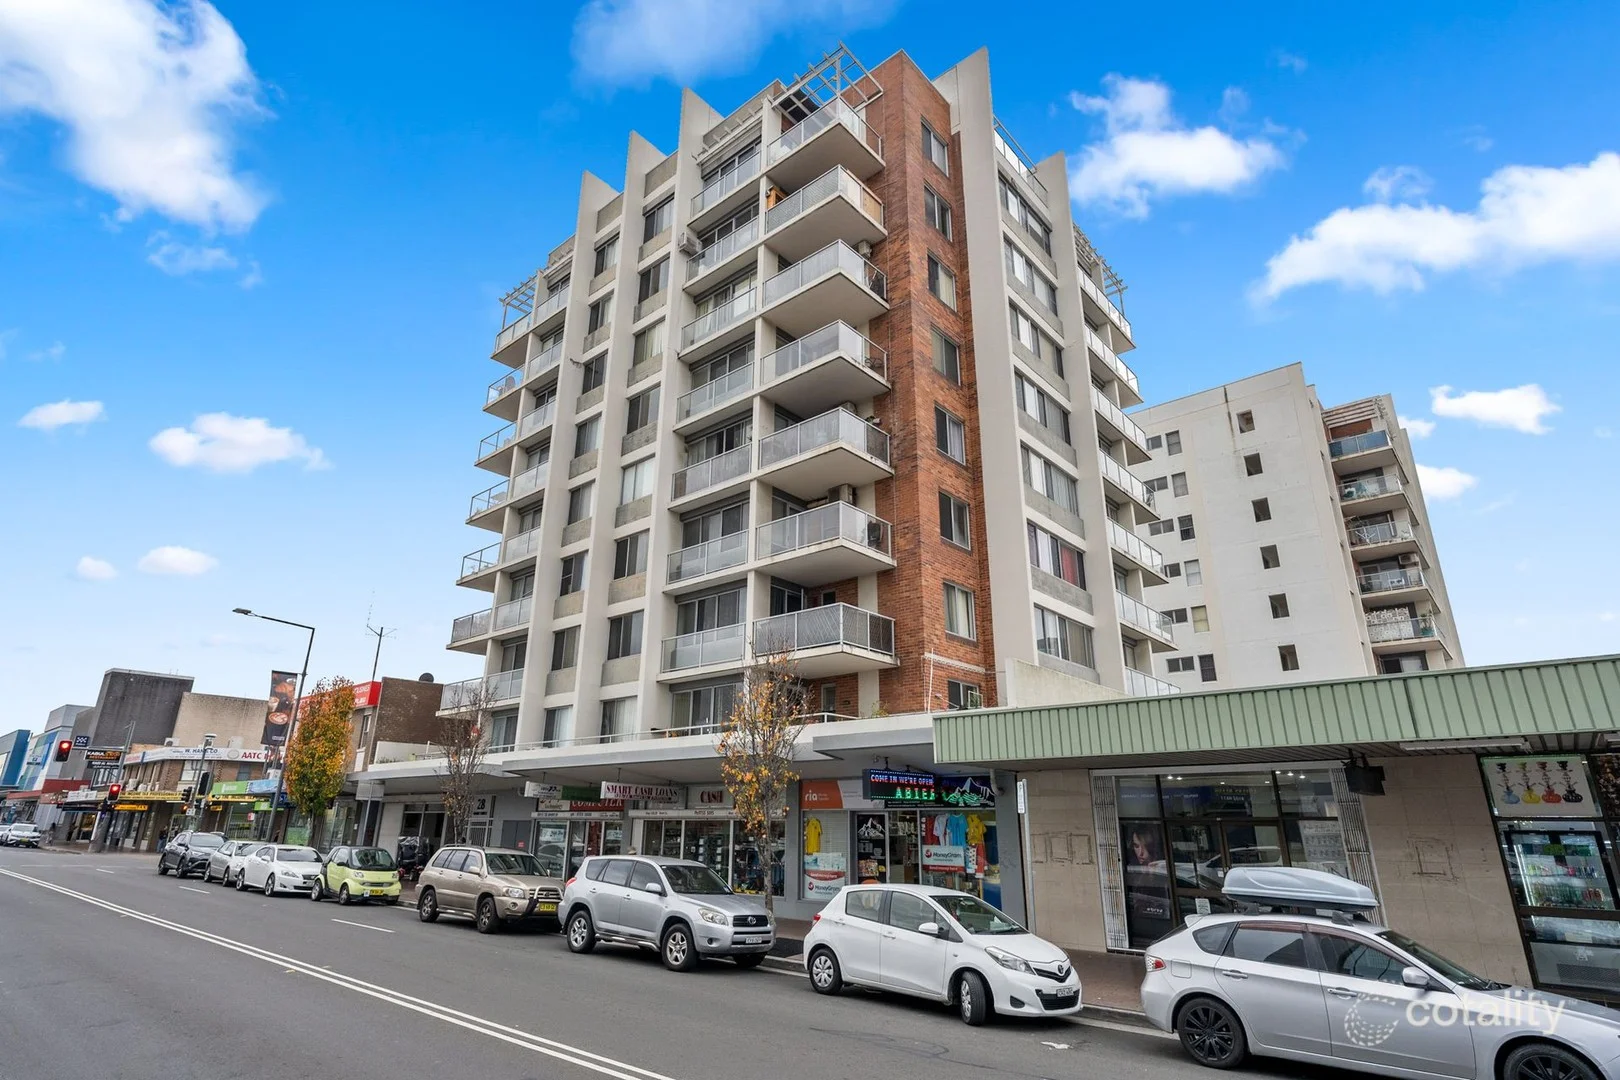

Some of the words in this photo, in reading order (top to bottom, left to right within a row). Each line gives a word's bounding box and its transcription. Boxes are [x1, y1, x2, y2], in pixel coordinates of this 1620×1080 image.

[871, 774, 888, 782] COME
[606, 785, 632, 796] SMART
[634, 785, 653, 797] CASH
[655, 786, 679, 798] LOANS
[700, 790, 724, 804] CASH
[805, 789, 818, 802] ria
[477, 798, 487, 810] 28
[932, 851, 963, 859] MoneyGram
